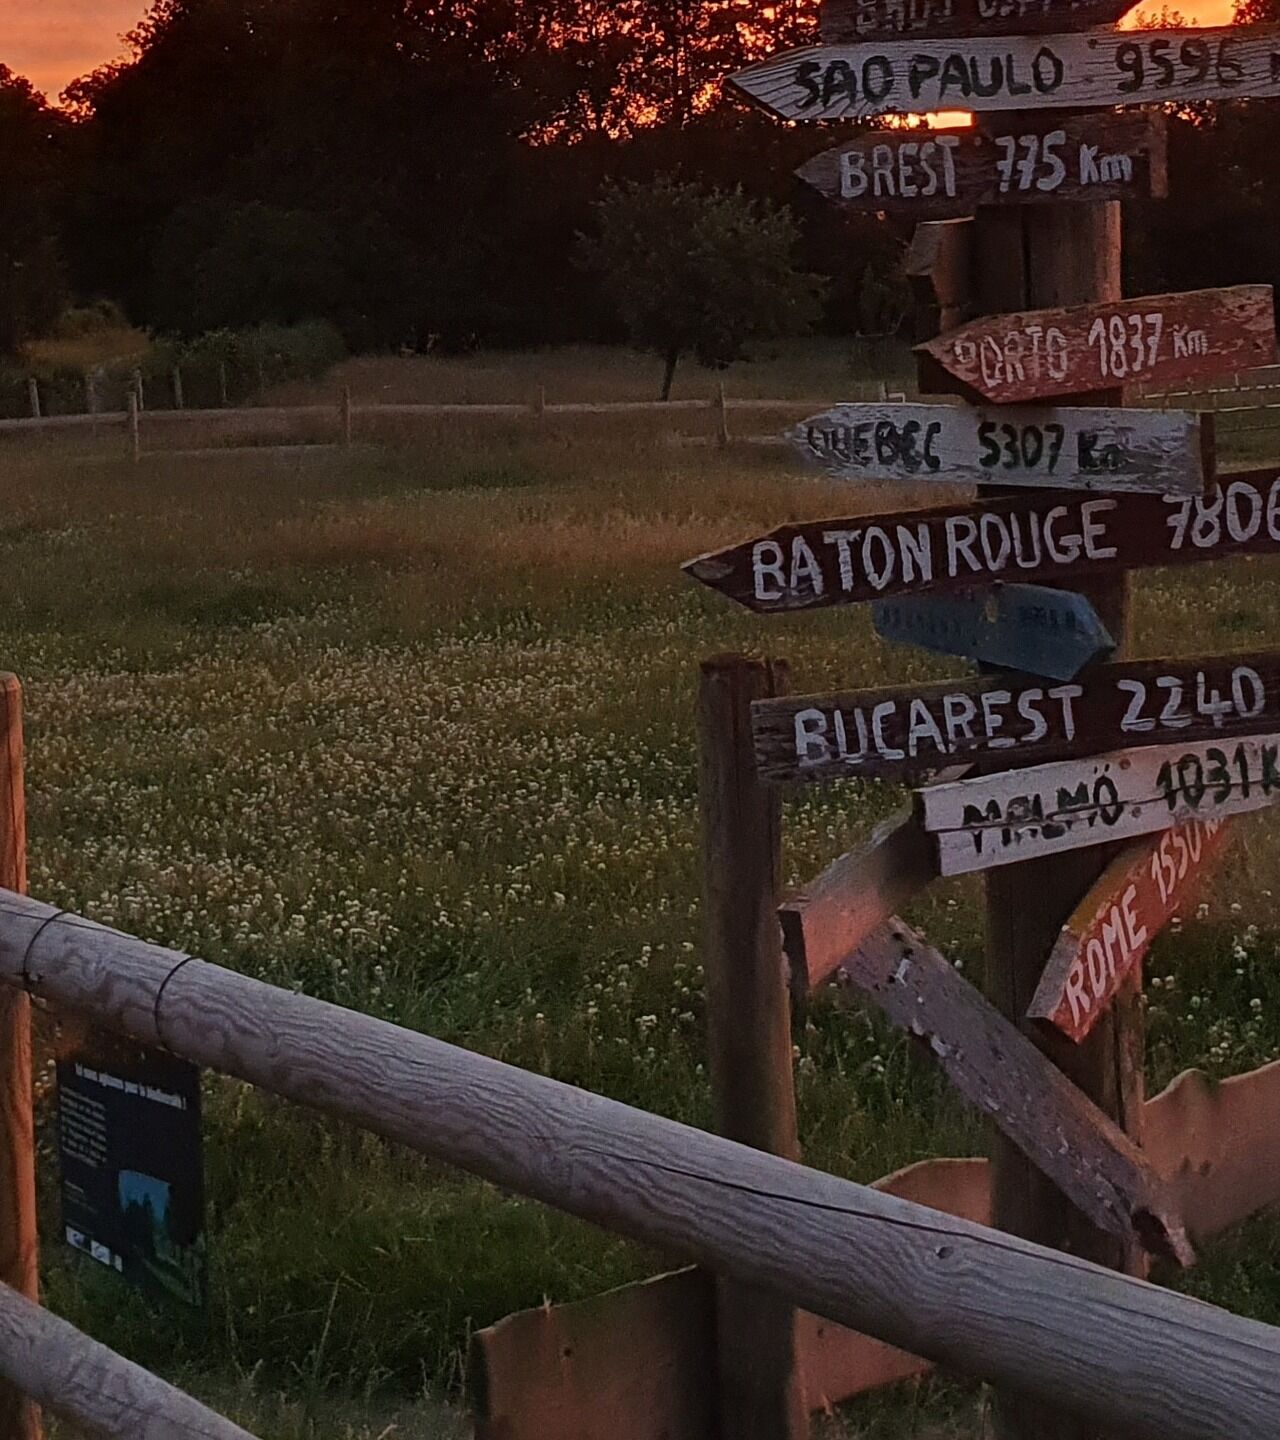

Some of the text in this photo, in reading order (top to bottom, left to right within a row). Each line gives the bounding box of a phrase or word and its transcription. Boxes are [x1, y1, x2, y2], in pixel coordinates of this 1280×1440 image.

[794, 55, 894, 107] SAO
[910, 46, 1062, 100] PAULO
[839, 130, 1133, 200] BREST 775 Km
[953, 312, 1208, 388] PORTO 1837 Km
[979, 424, 1066, 471] 5307
[750, 523, 933, 602] BATON
[945, 498, 1119, 578] ROUGE
[792, 683, 1086, 767] BUCAREST
[1119, 666, 1267, 733] 2240
[1156, 741, 1251, 811] 1031
[1065, 884, 1148, 1028] ROME
